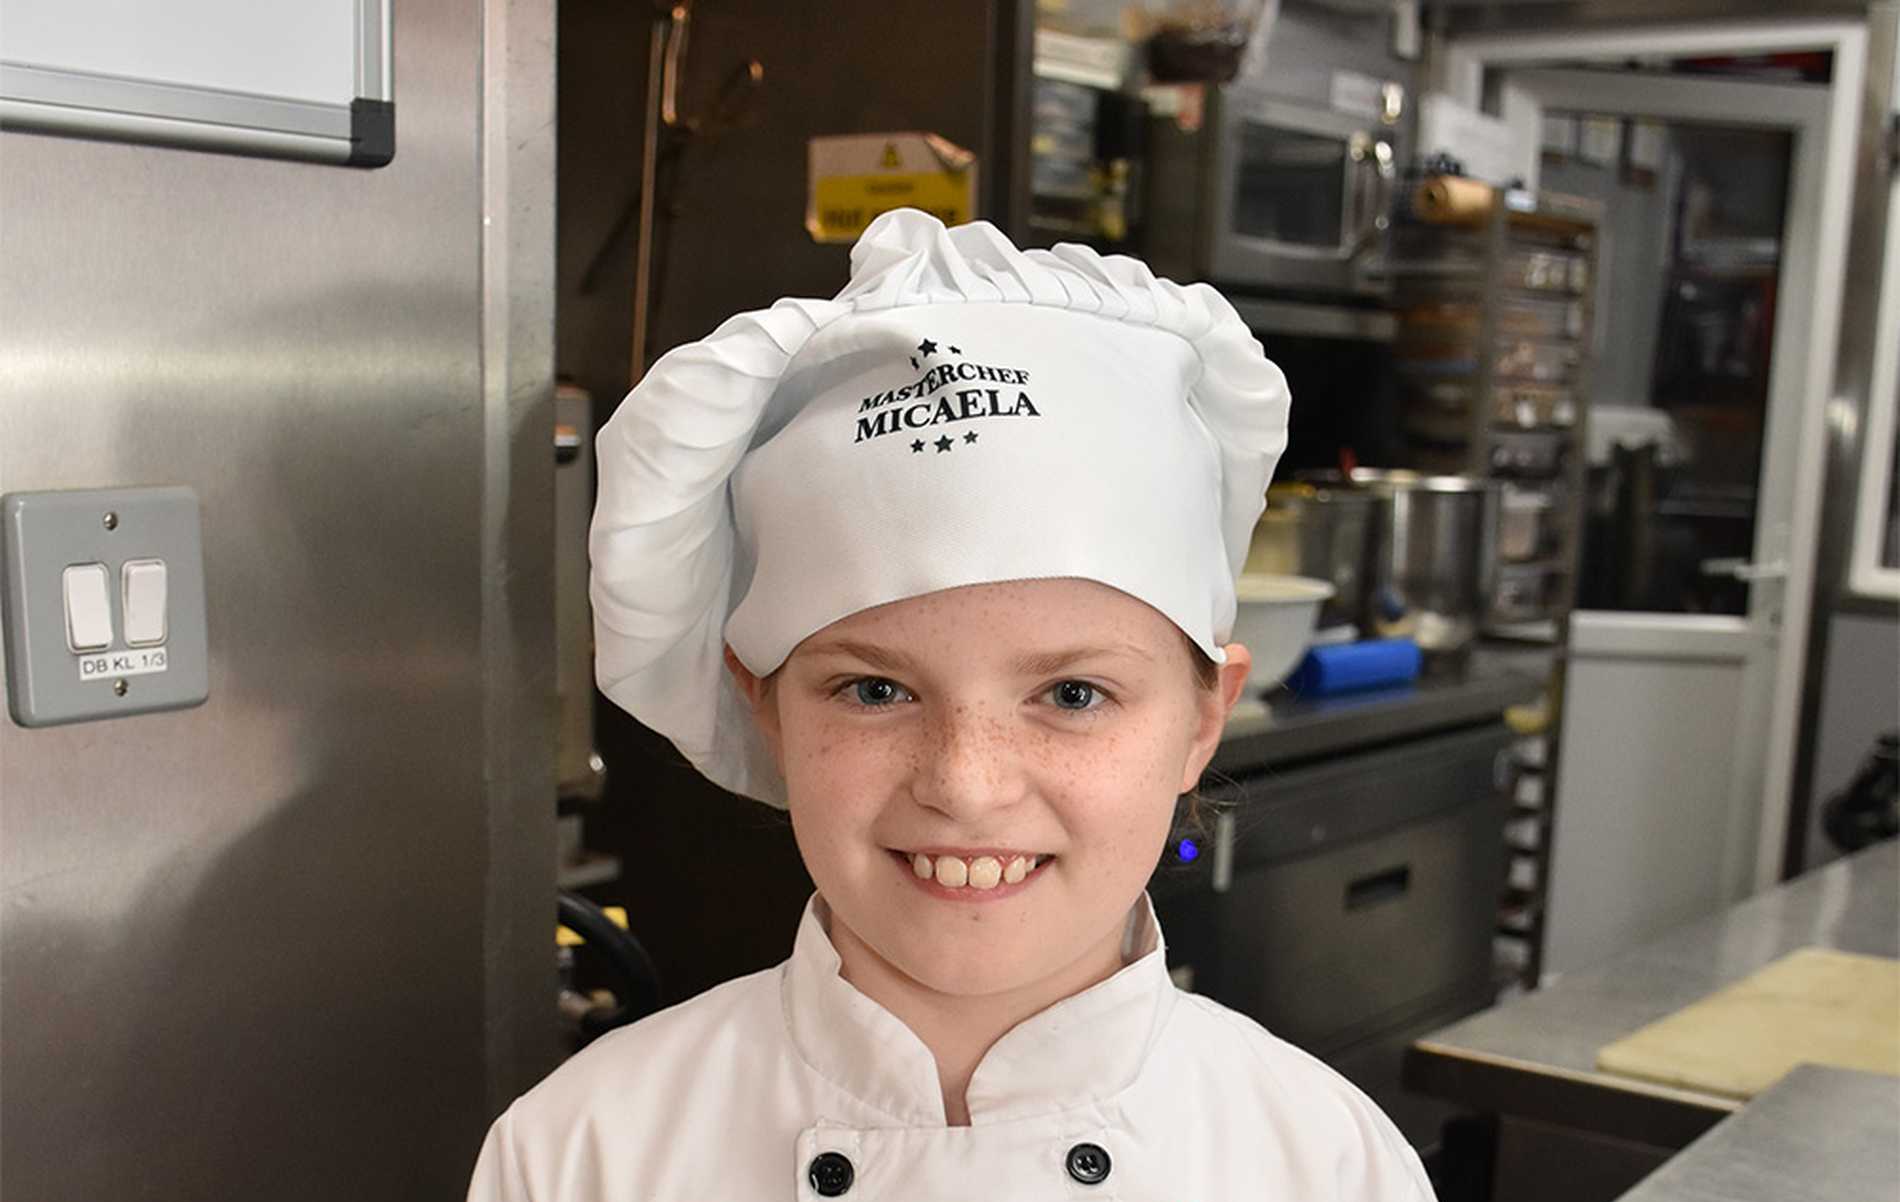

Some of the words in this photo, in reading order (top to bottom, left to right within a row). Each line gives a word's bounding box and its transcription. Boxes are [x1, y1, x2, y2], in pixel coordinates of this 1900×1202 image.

[858, 363, 1030, 413] MASTERCHEF
[854, 389, 1041, 443] MICAELA
[83, 660, 108, 675] DB
[113, 657, 135, 671] KL
[142, 653, 165, 666] 1/3
